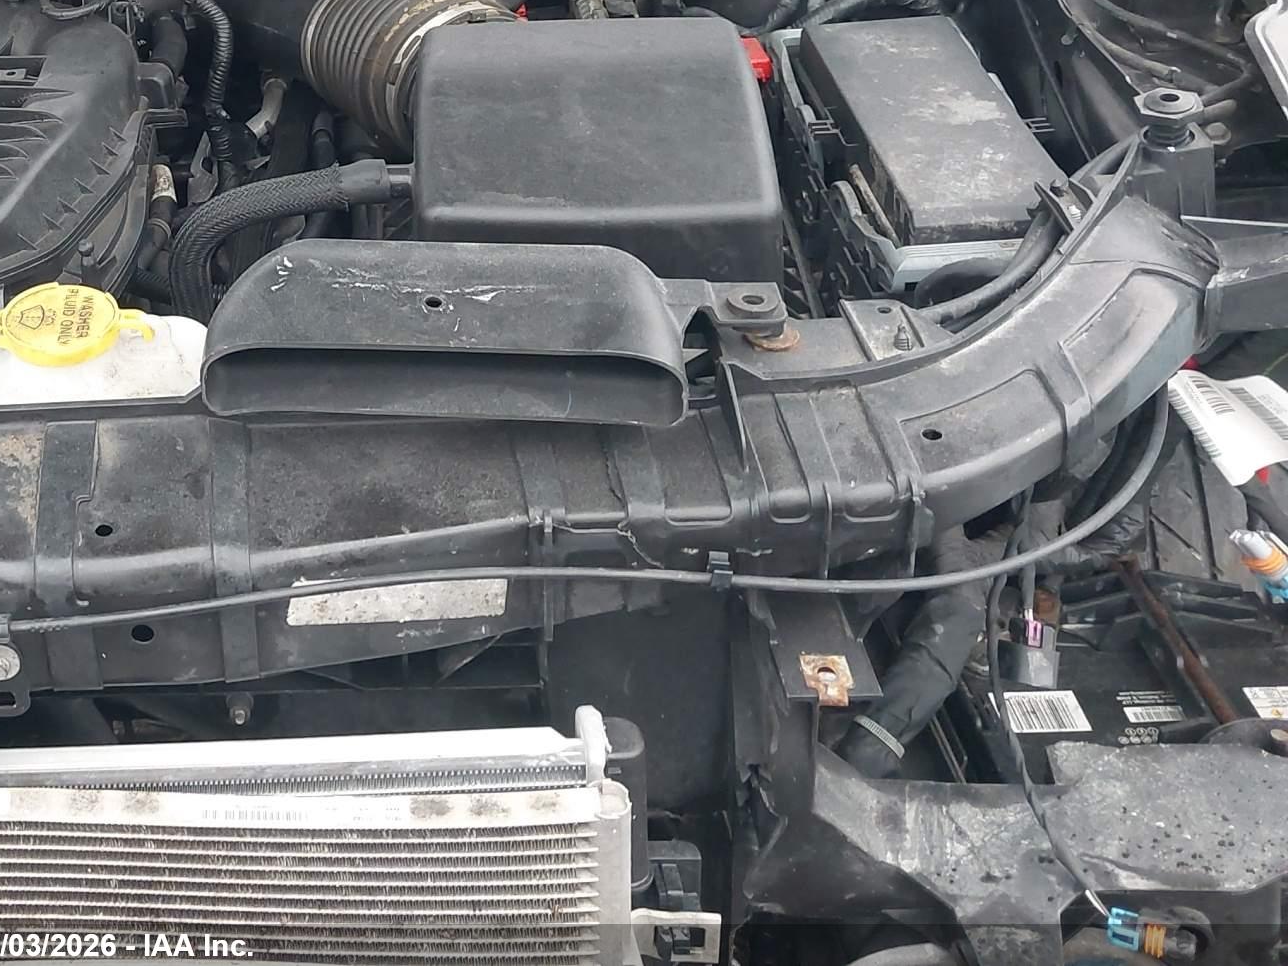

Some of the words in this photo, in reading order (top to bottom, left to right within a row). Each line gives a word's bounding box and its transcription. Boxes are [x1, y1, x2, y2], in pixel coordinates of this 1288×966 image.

[63, 288, 78, 316] FLUID
[76, 296, 93, 338] WASHER
[57, 319, 73, 345] ONLY
